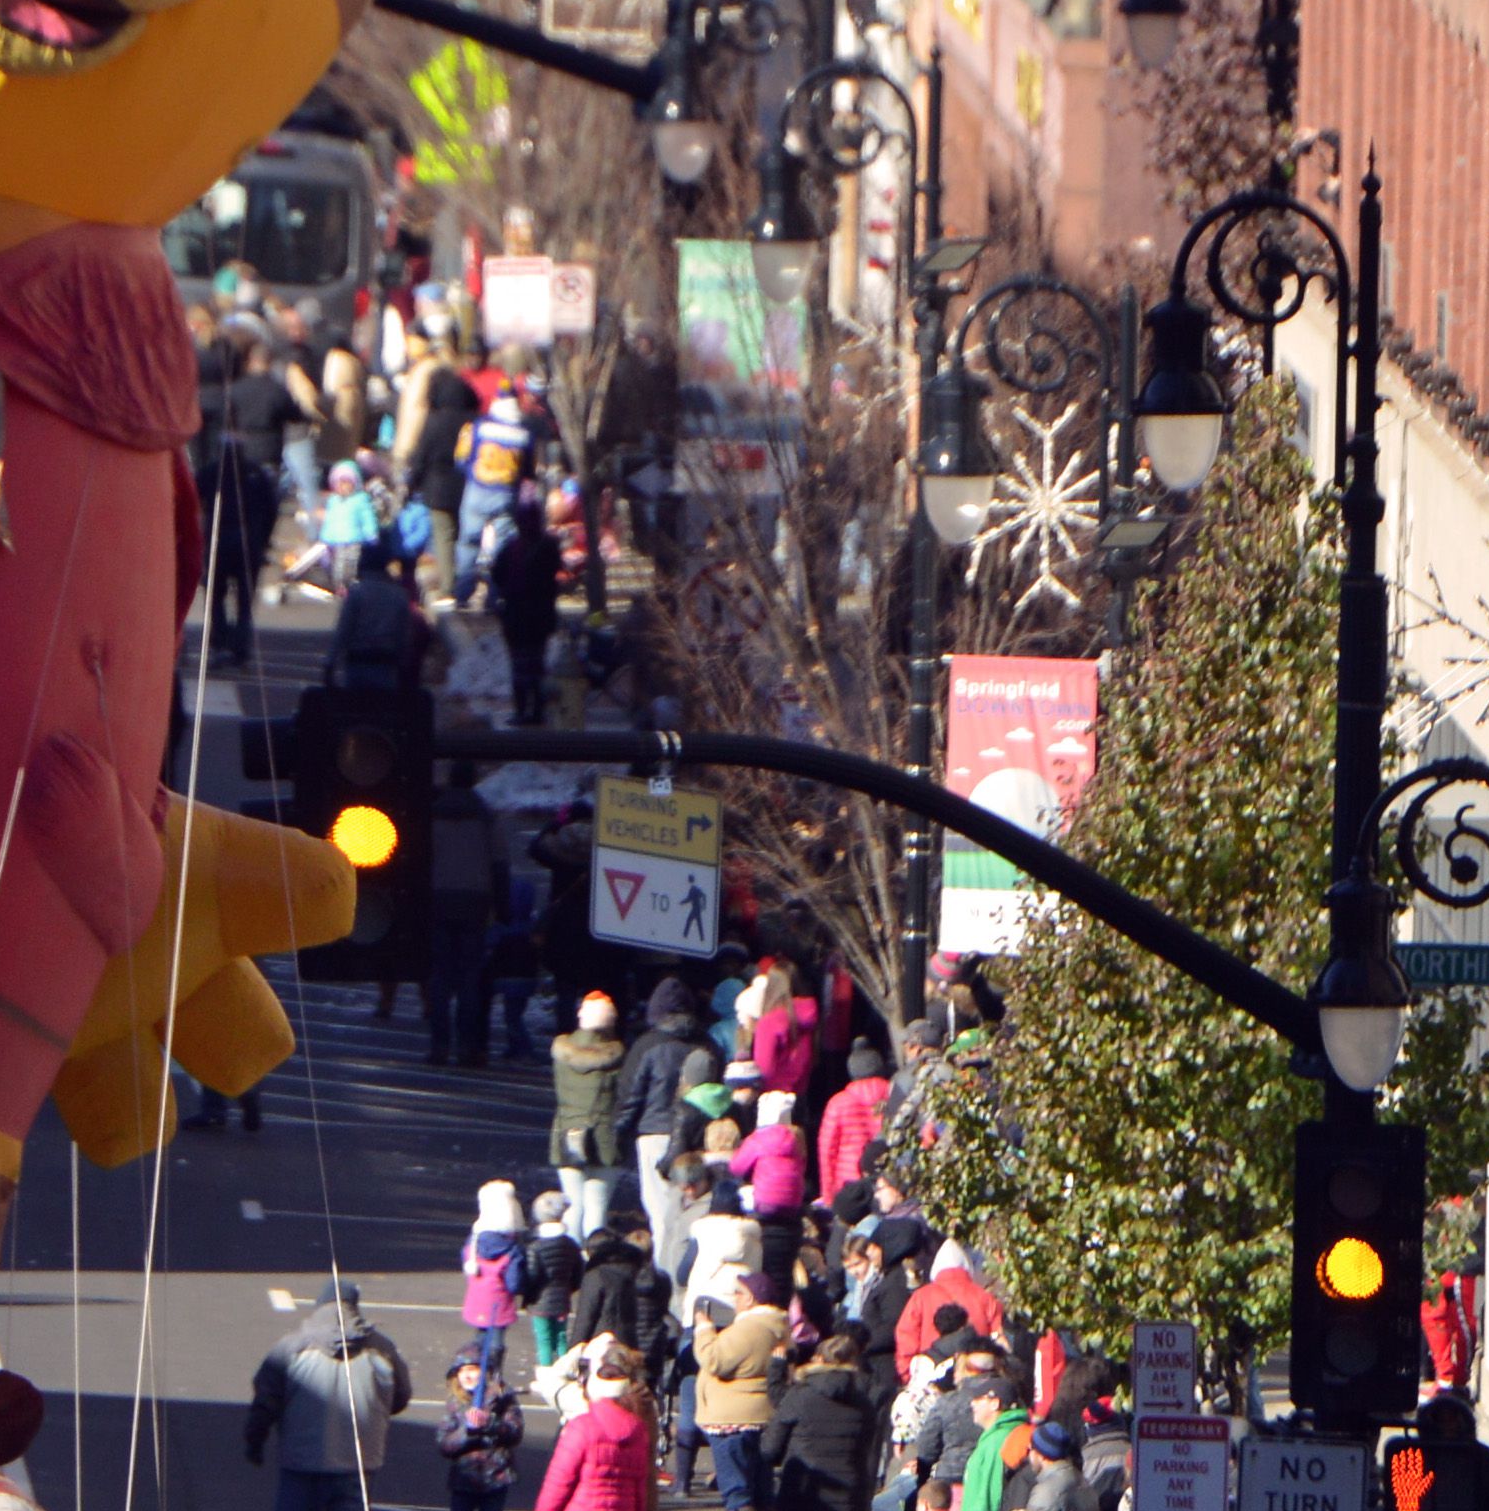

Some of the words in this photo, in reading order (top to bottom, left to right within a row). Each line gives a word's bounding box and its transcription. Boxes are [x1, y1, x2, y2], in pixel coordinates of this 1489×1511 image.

[609, 788, 678, 817] TURNING
[606, 819, 679, 847] VEHICLES
[650, 892, 670, 913] TO
[1152, 1331, 1176, 1349] NO
[1137, 1352, 1192, 1370] PARKING
[1152, 1372, 1176, 1383] ANY
[1151, 1385, 1178, 1398] TIME
[1142, 1422, 1223, 1436] TEMPORARY
[1172, 1443, 1191, 1455] NO
[1153, 1461, 1209, 1475] PARKING
[1280, 1456, 1326, 1482] NO
[1166, 1479, 1194, 1492] ANY
[1164, 1496, 1195, 1510] TIME
